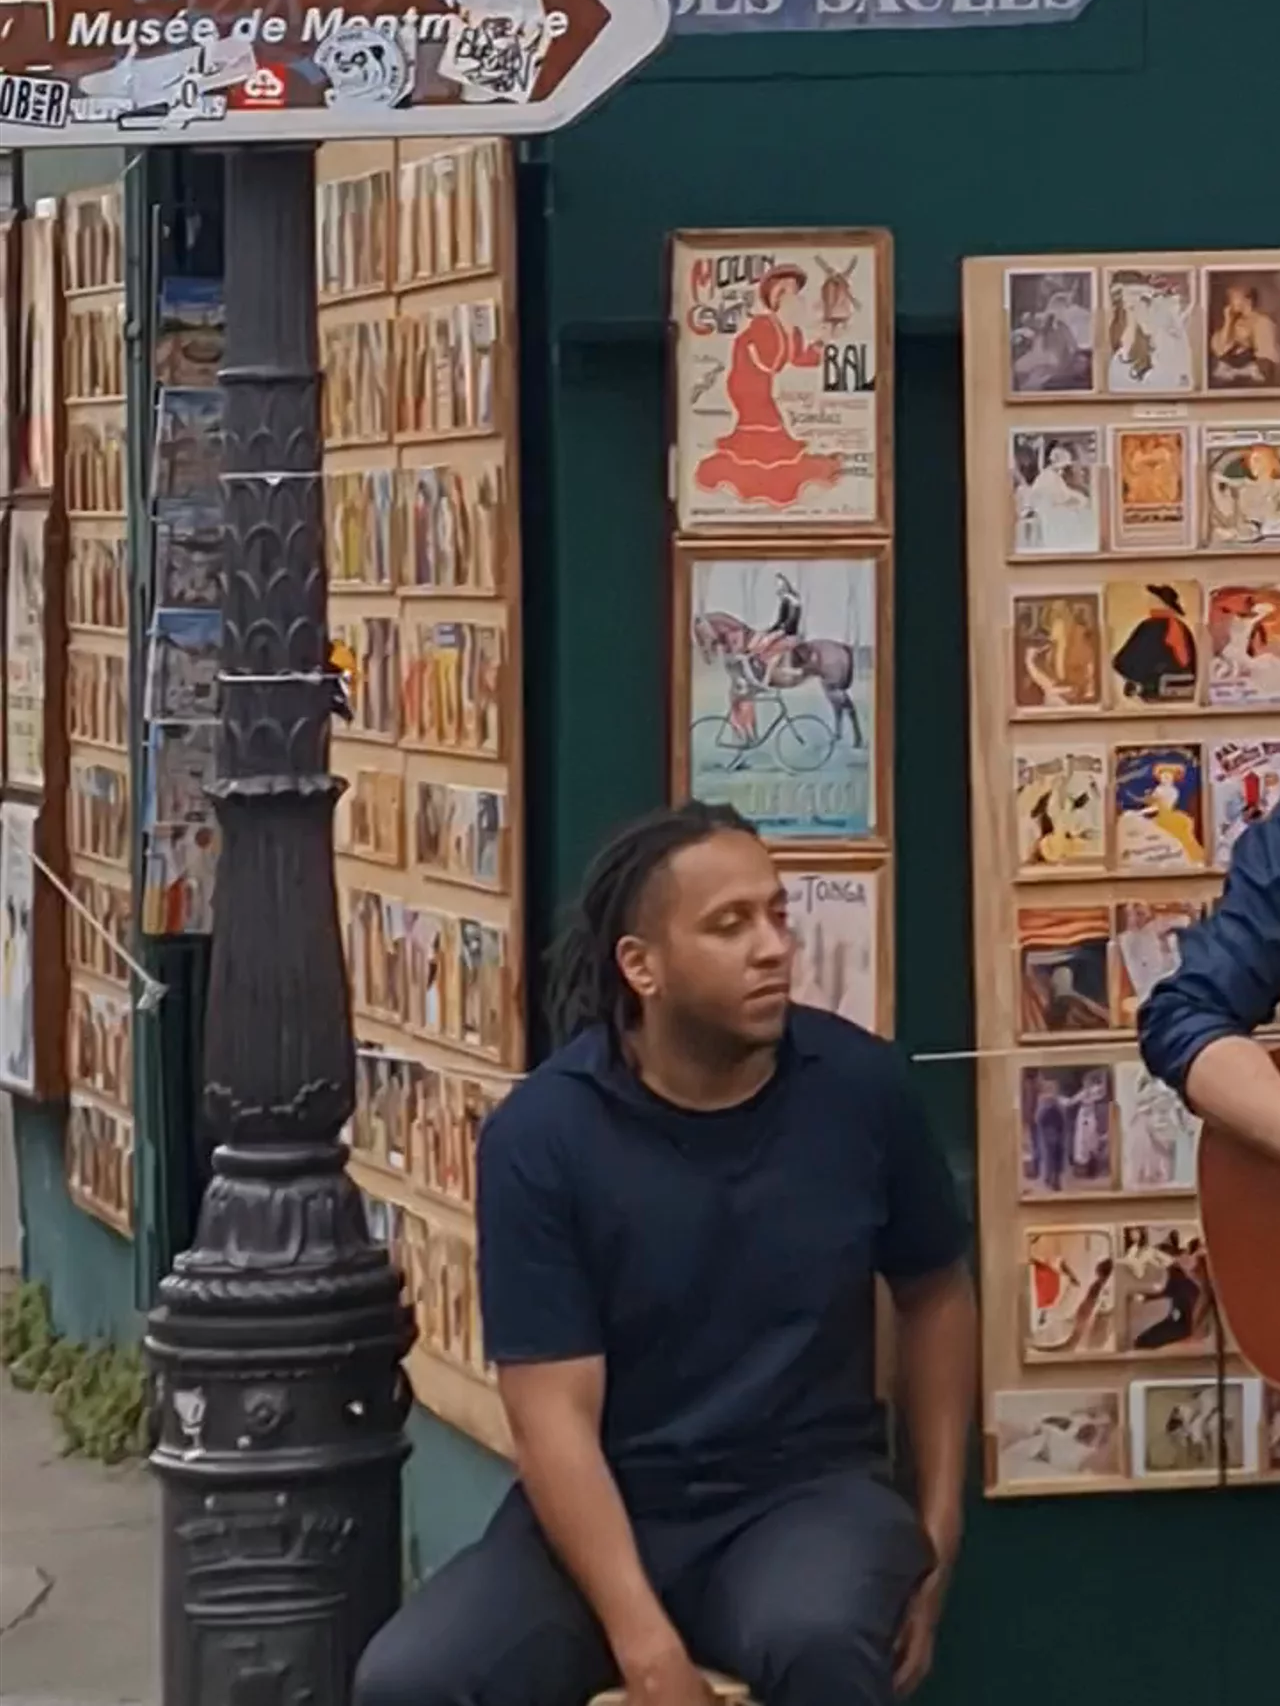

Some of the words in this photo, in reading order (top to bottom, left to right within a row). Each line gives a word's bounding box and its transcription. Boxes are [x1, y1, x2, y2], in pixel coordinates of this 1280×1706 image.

[68, 7, 220, 47] Musée
[230, 8, 287, 42] de
[301, 6, 569, 43] Montme
[823, 344, 876, 392] BAL
